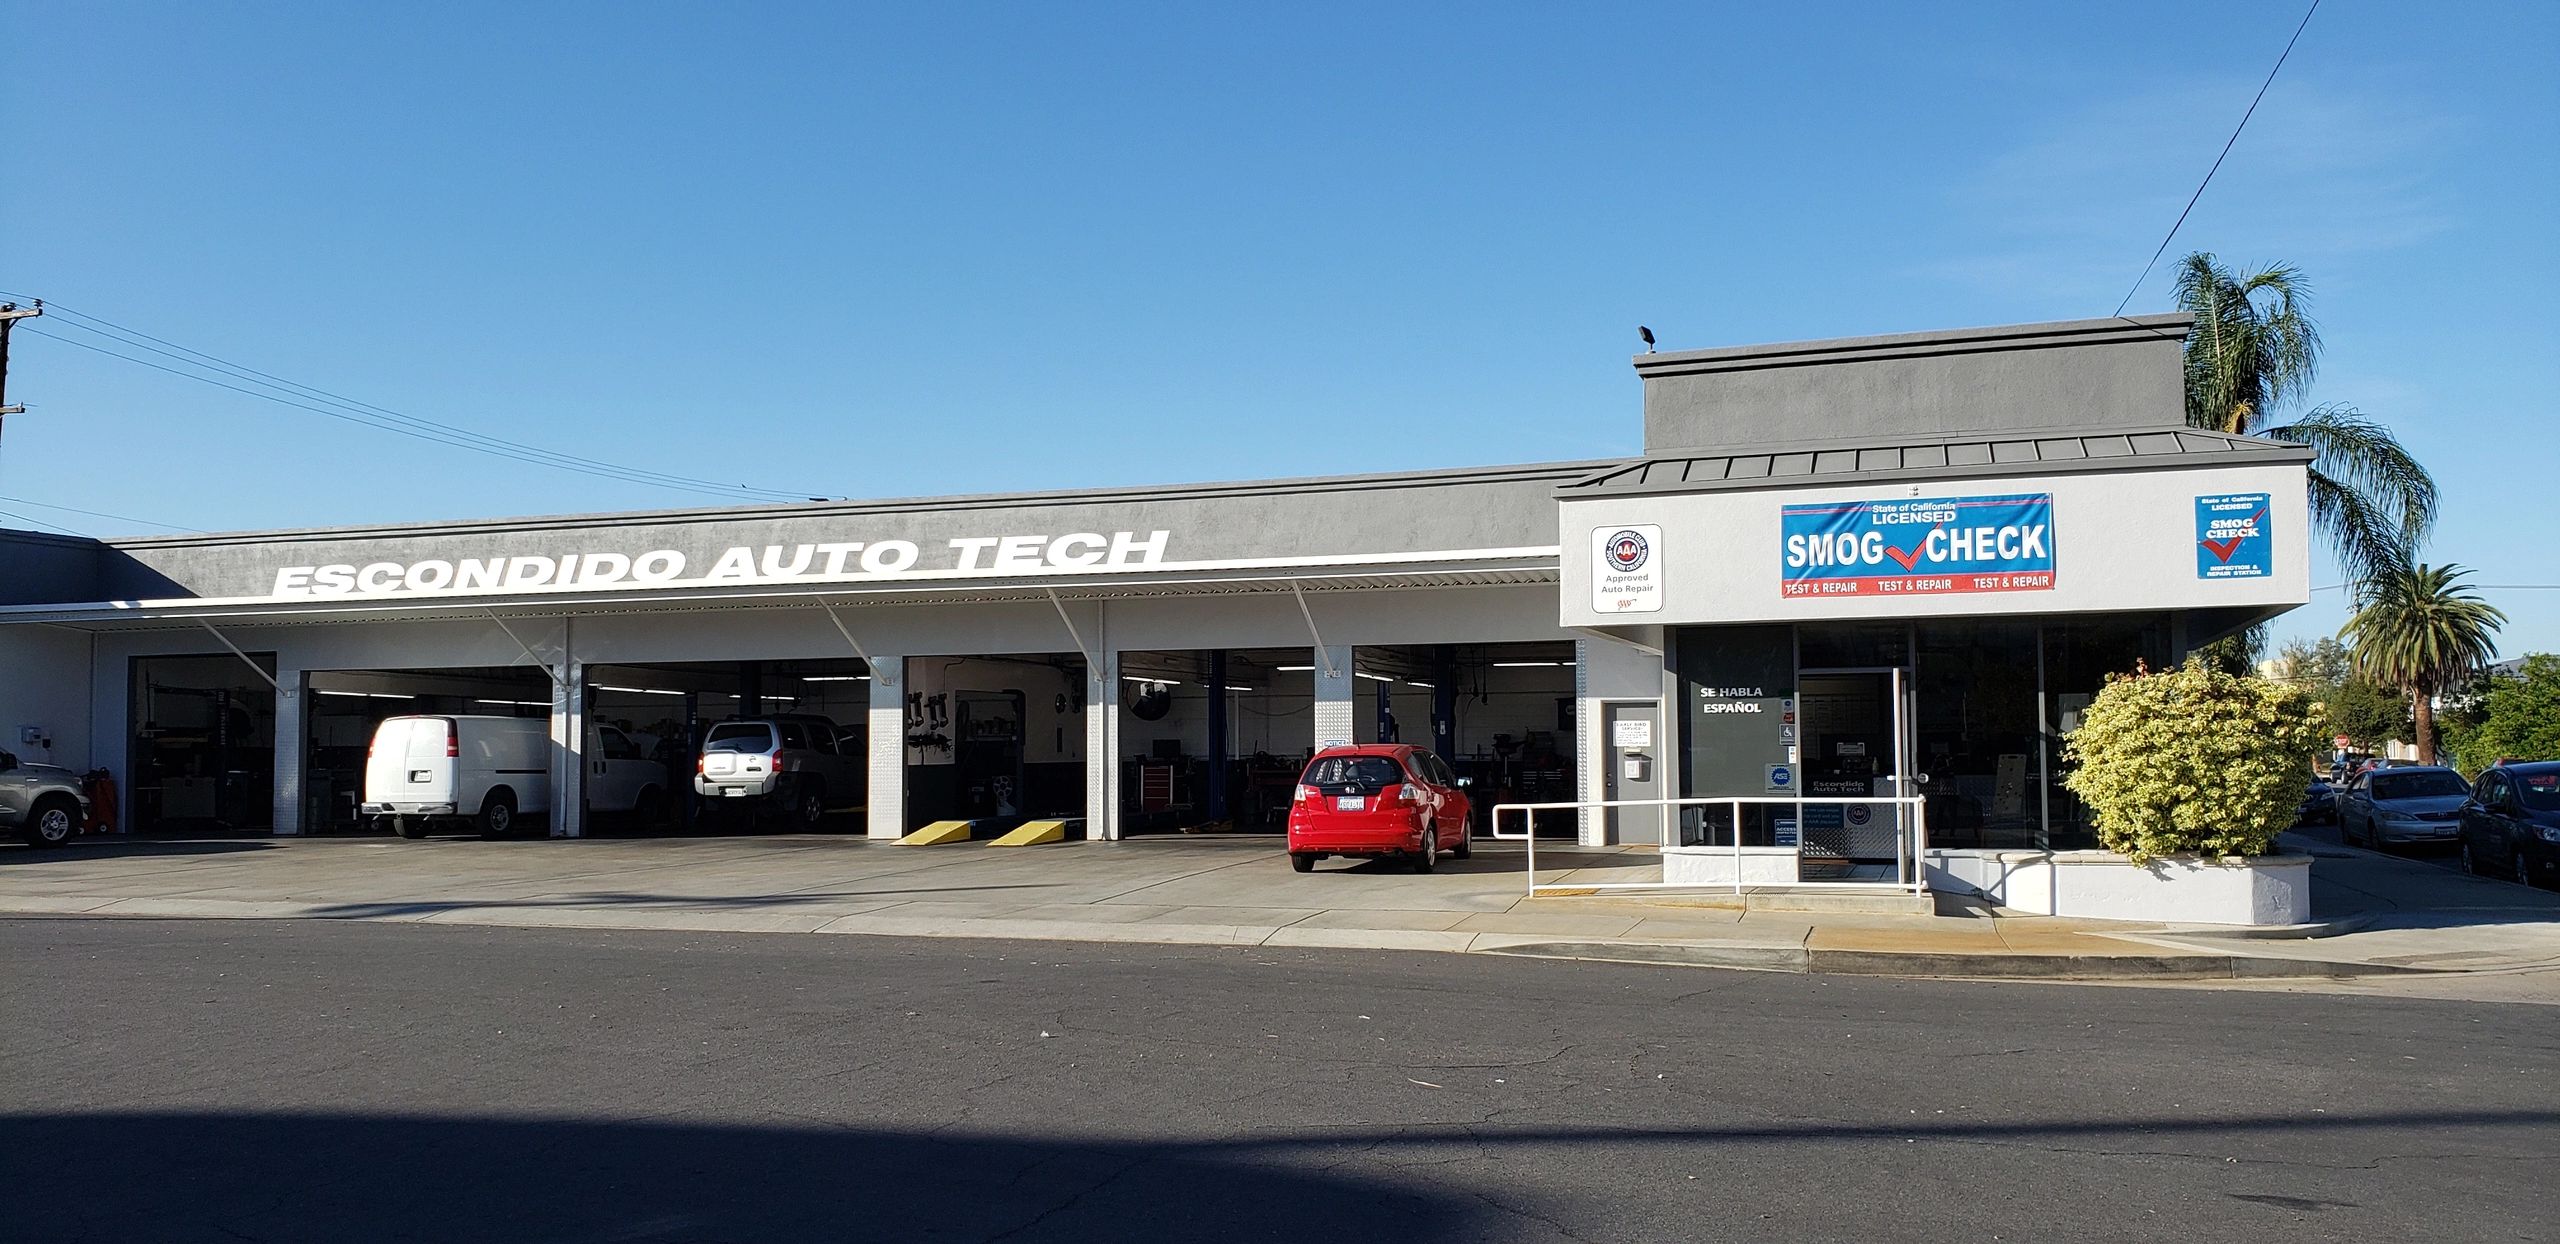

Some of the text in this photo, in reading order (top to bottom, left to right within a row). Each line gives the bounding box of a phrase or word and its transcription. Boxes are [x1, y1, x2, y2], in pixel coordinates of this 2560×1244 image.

[1872, 502, 1956, 513] State of California
[2211, 503, 2253, 511] LICENSED
[1872, 511, 1957, 525] LICENSED
[2210, 518, 2254, 529] SMOG
[2205, 527, 2260, 539] CHECK
[1616, 544, 1637, 556] AAA
[1787, 525, 2047, 568] SMOG CHECK
[272, 529, 1171, 598] ESCONDIDO AUTO TECH
[1605, 574, 1649, 583] Approved
[1973, 575, 2049, 588] TEST & REPAIR
[1625, 584, 1654, 594] Repair
[1785, 582, 1857, 594] TEST & REPAIR
[1878, 579, 1952, 591] TEST & REPAIR
[1700, 687, 1763, 697] SE HABLA
[1703, 701, 1762, 713] ESPAÑOL
[1773, 772, 1789, 780] ASE
